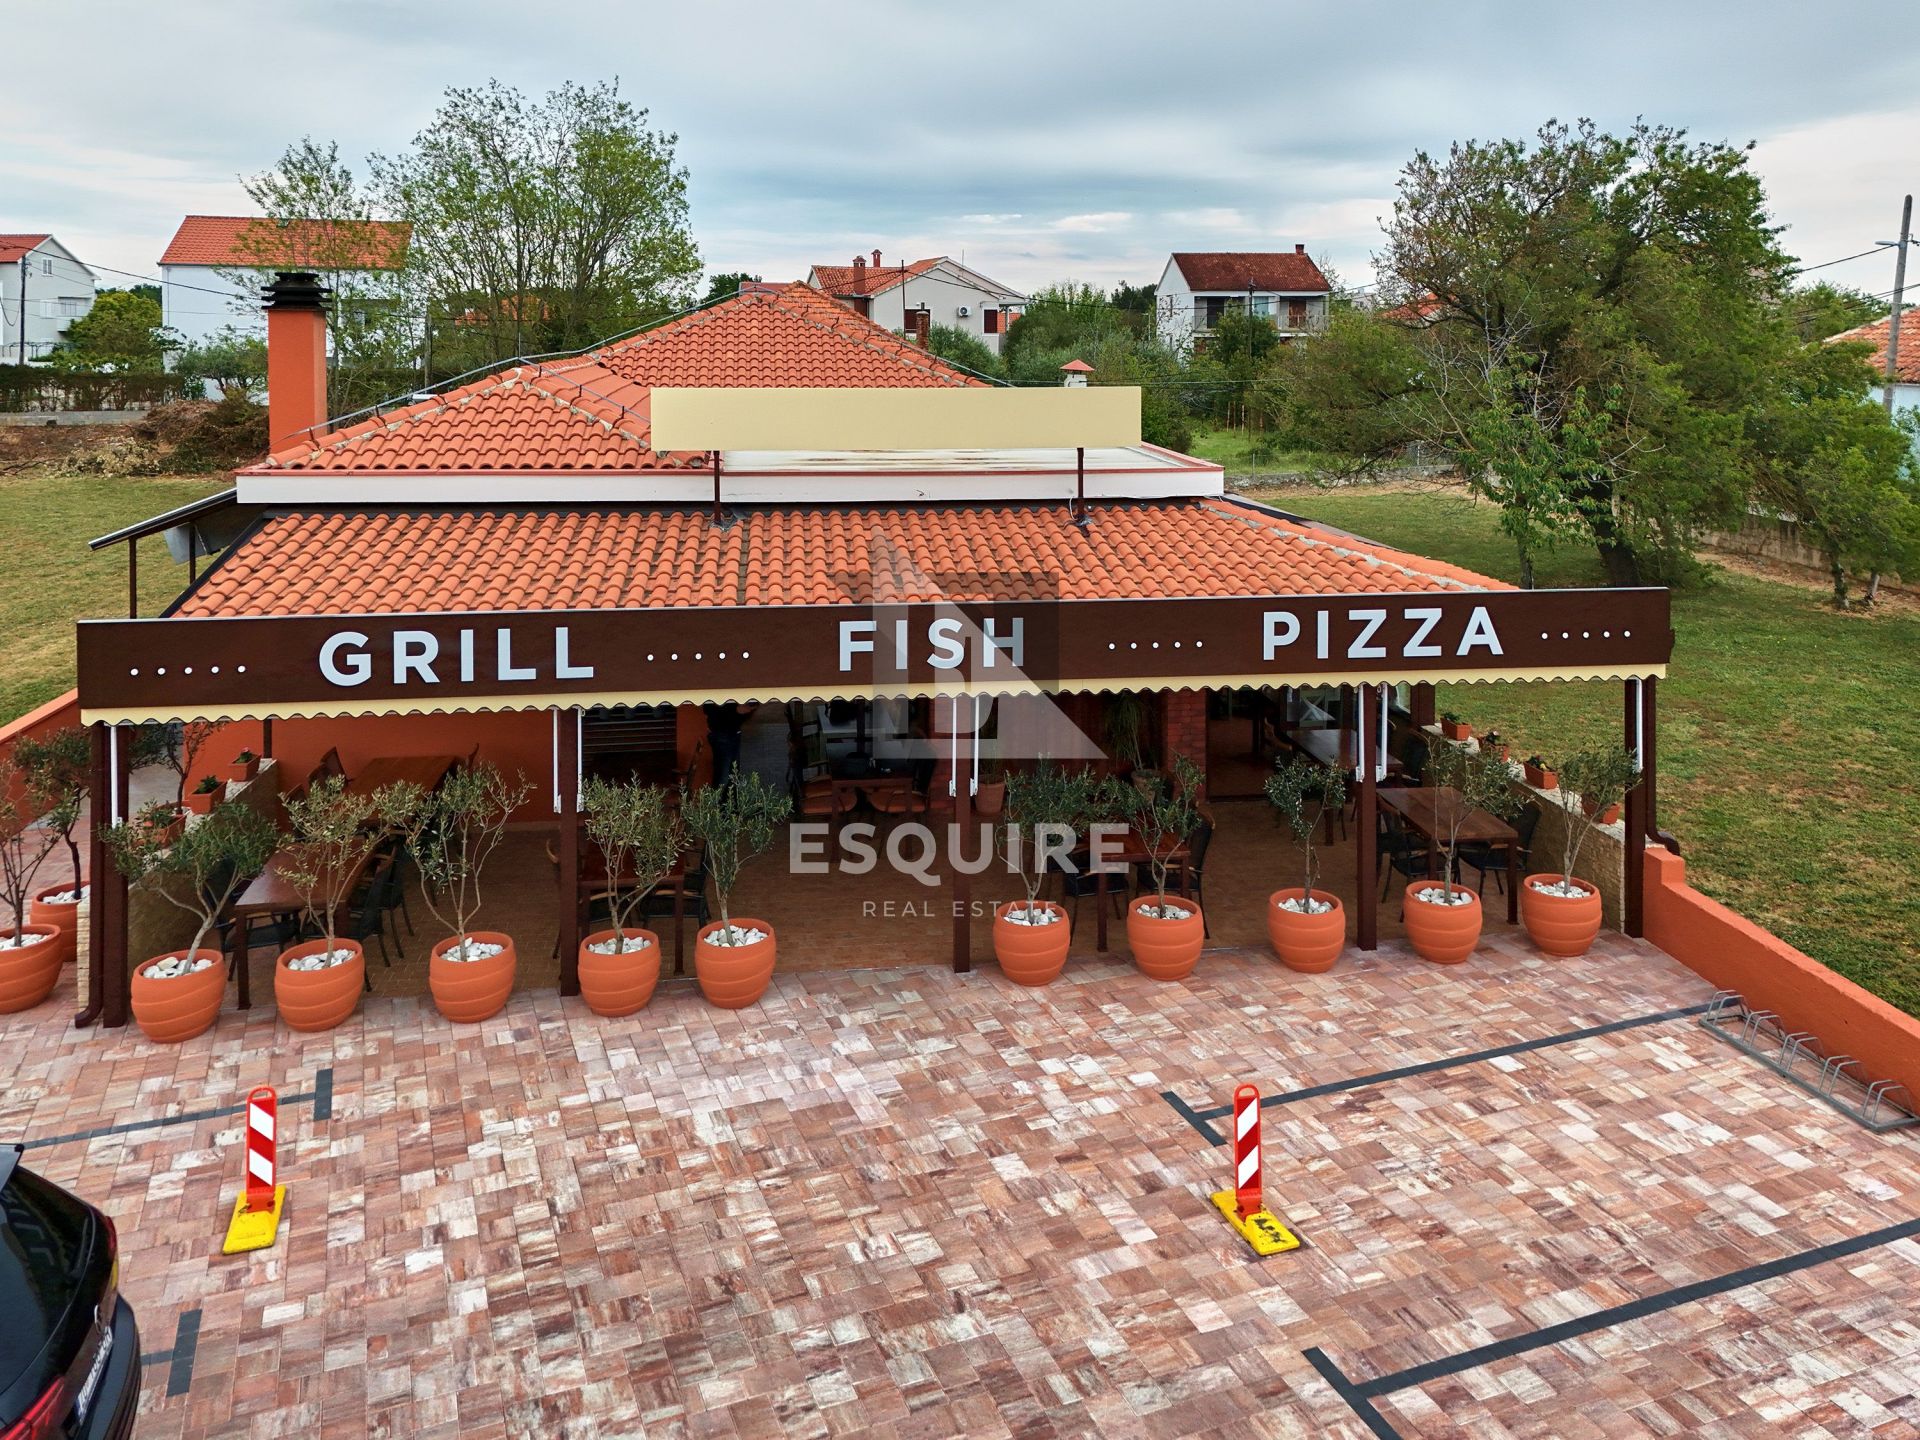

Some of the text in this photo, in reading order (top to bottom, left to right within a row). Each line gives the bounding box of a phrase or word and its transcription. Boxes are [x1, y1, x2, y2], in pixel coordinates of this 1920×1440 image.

[318, 606, 1504, 687] GRILL FISH PIZZA
